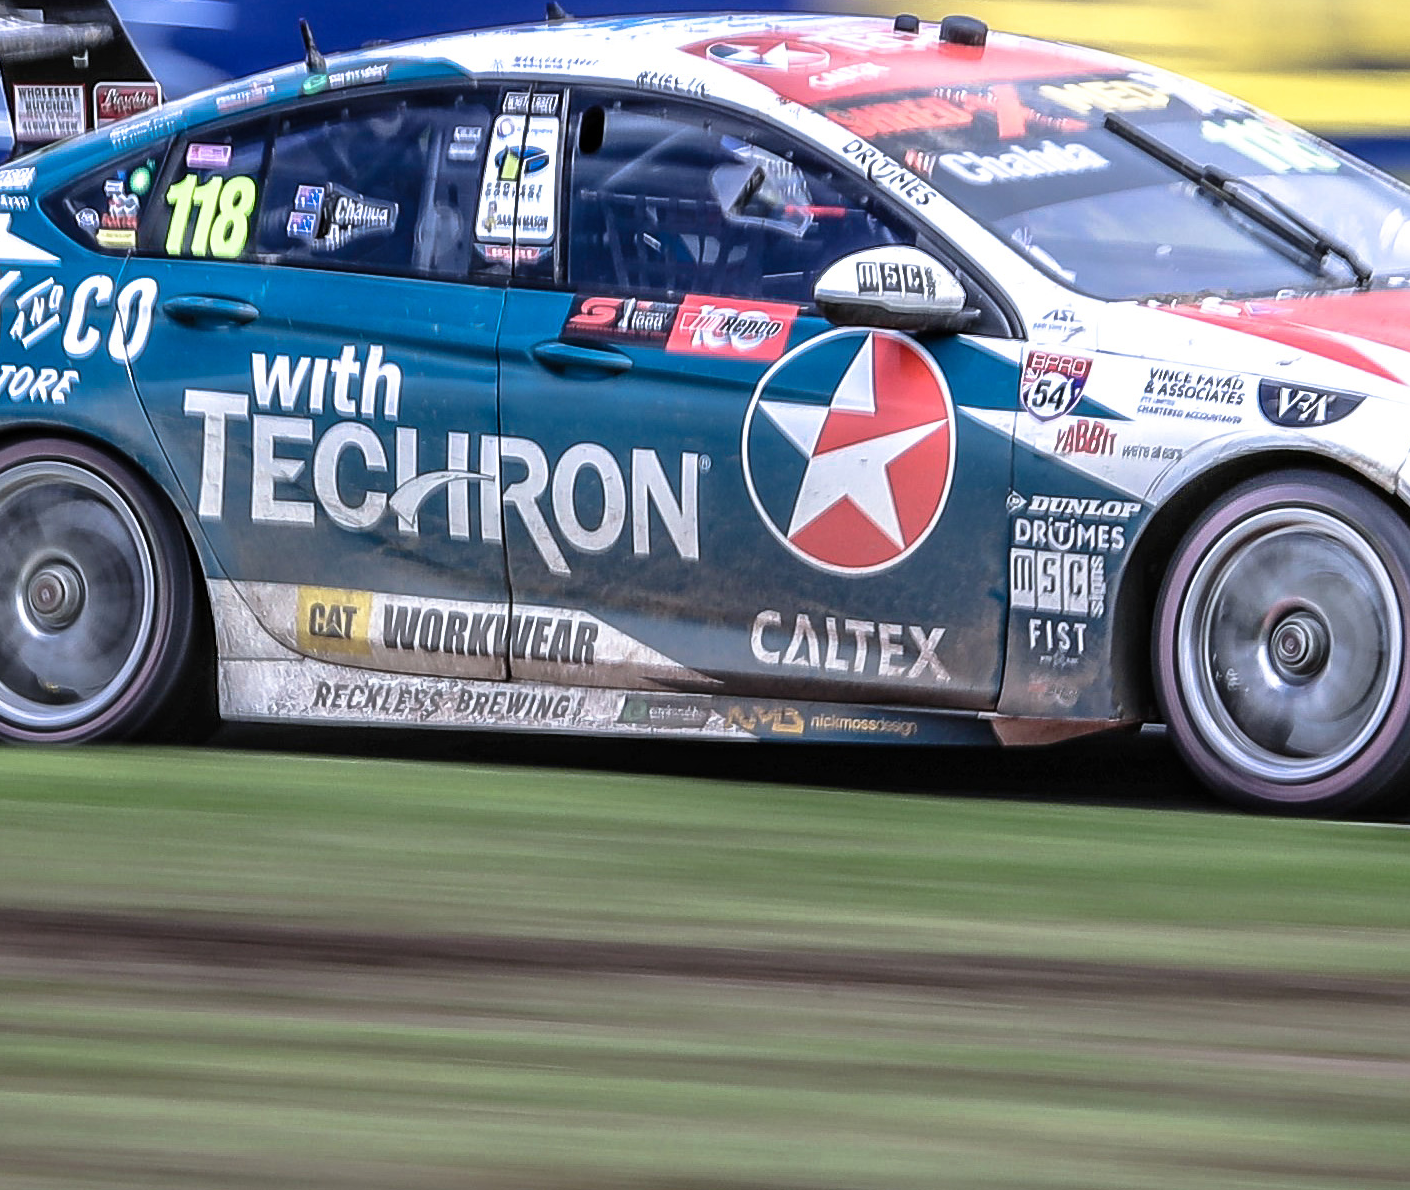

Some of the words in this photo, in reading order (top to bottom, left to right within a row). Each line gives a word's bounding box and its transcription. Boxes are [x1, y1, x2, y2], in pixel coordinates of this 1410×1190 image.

[18, 87, 80, 99] WHOLESALE
[165, 174, 257, 257] 118
[855, 262, 925, 294] MSC
[62, 274, 161, 363] CO
[250, 344, 404, 422] with
[1144, 379, 1156, 394] &
[1157, 382, 1246, 407] ASSOCIATES
[1149, 367, 1192, 385] VINCE
[1031, 379, 1068, 412] 54
[1136, 405, 1184, 418] CHARTERED
[1054, 418, 1118, 456] YABBIT
[184, 388, 702, 578] TECHRON
[1028, 495, 1142, 519] DUNLOP
[1011, 550, 1087, 607] MSC
[308, 602, 358, 641] CAT
[382, 603, 600, 665] WORKWEAR
[749, 609, 952, 683] CALTEX
[1028, 618, 1088, 656] FIST
[311, 680, 450, 719] RECKLESS
[810, 714, 918, 736] nickmossdesign
